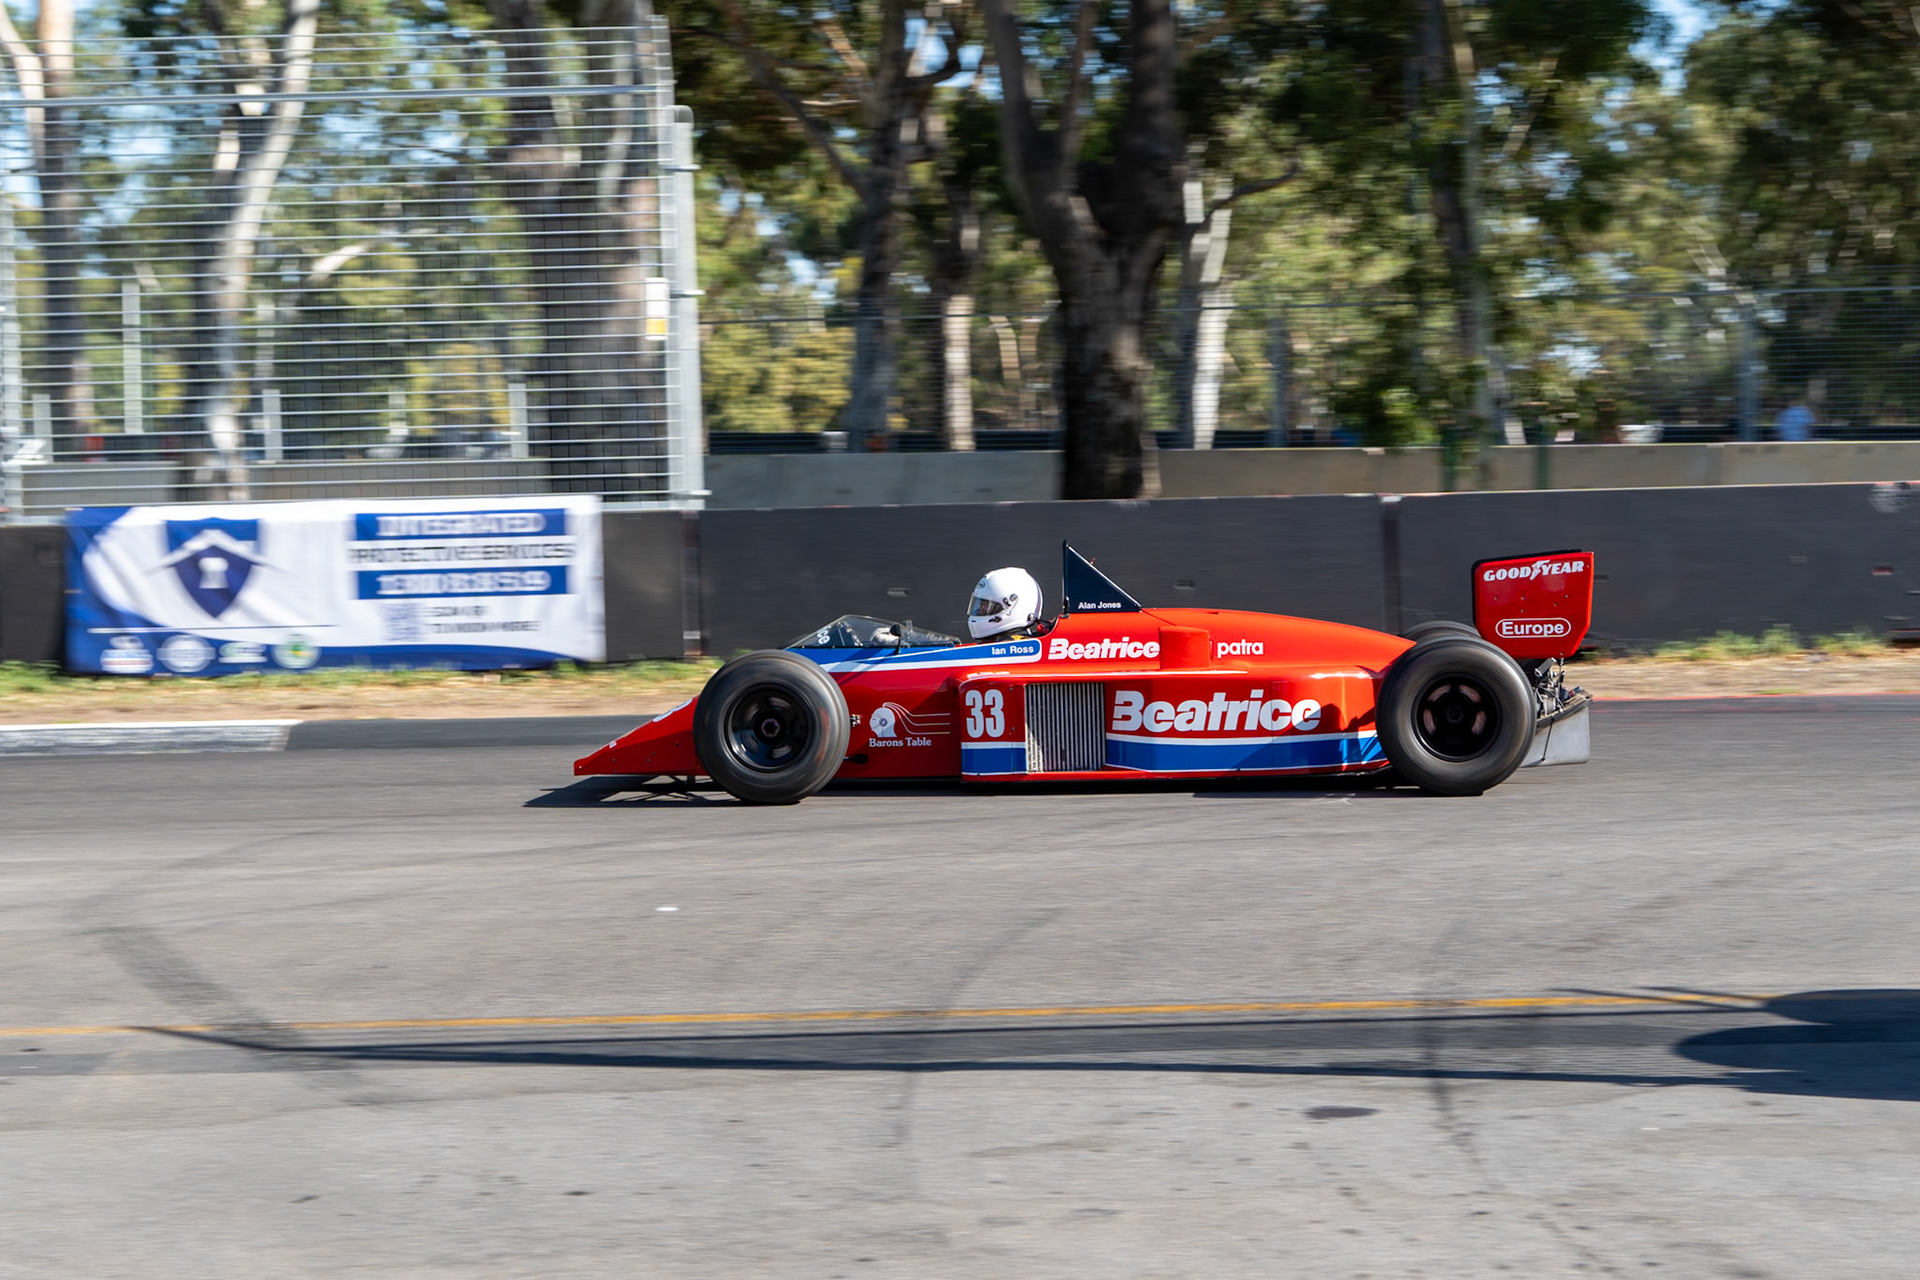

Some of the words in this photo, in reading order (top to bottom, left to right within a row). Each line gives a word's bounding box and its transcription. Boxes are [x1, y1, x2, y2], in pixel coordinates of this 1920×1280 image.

[1078, 601, 1096, 610] Alan
[1097, 601, 1122, 609] Jones
[1502, 622, 1564, 636] Europe
[991, 646, 1006, 655] Ian
[1010, 645, 1034, 654] Ross
[1048, 637, 1159, 660] Beatrice
[1217, 639, 1264, 658] patra
[965, 689, 1005, 738] 33
[1112, 689, 1321, 733] Beatrice
[869, 738, 903, 747] Barons
[905, 737, 932, 746] Table
